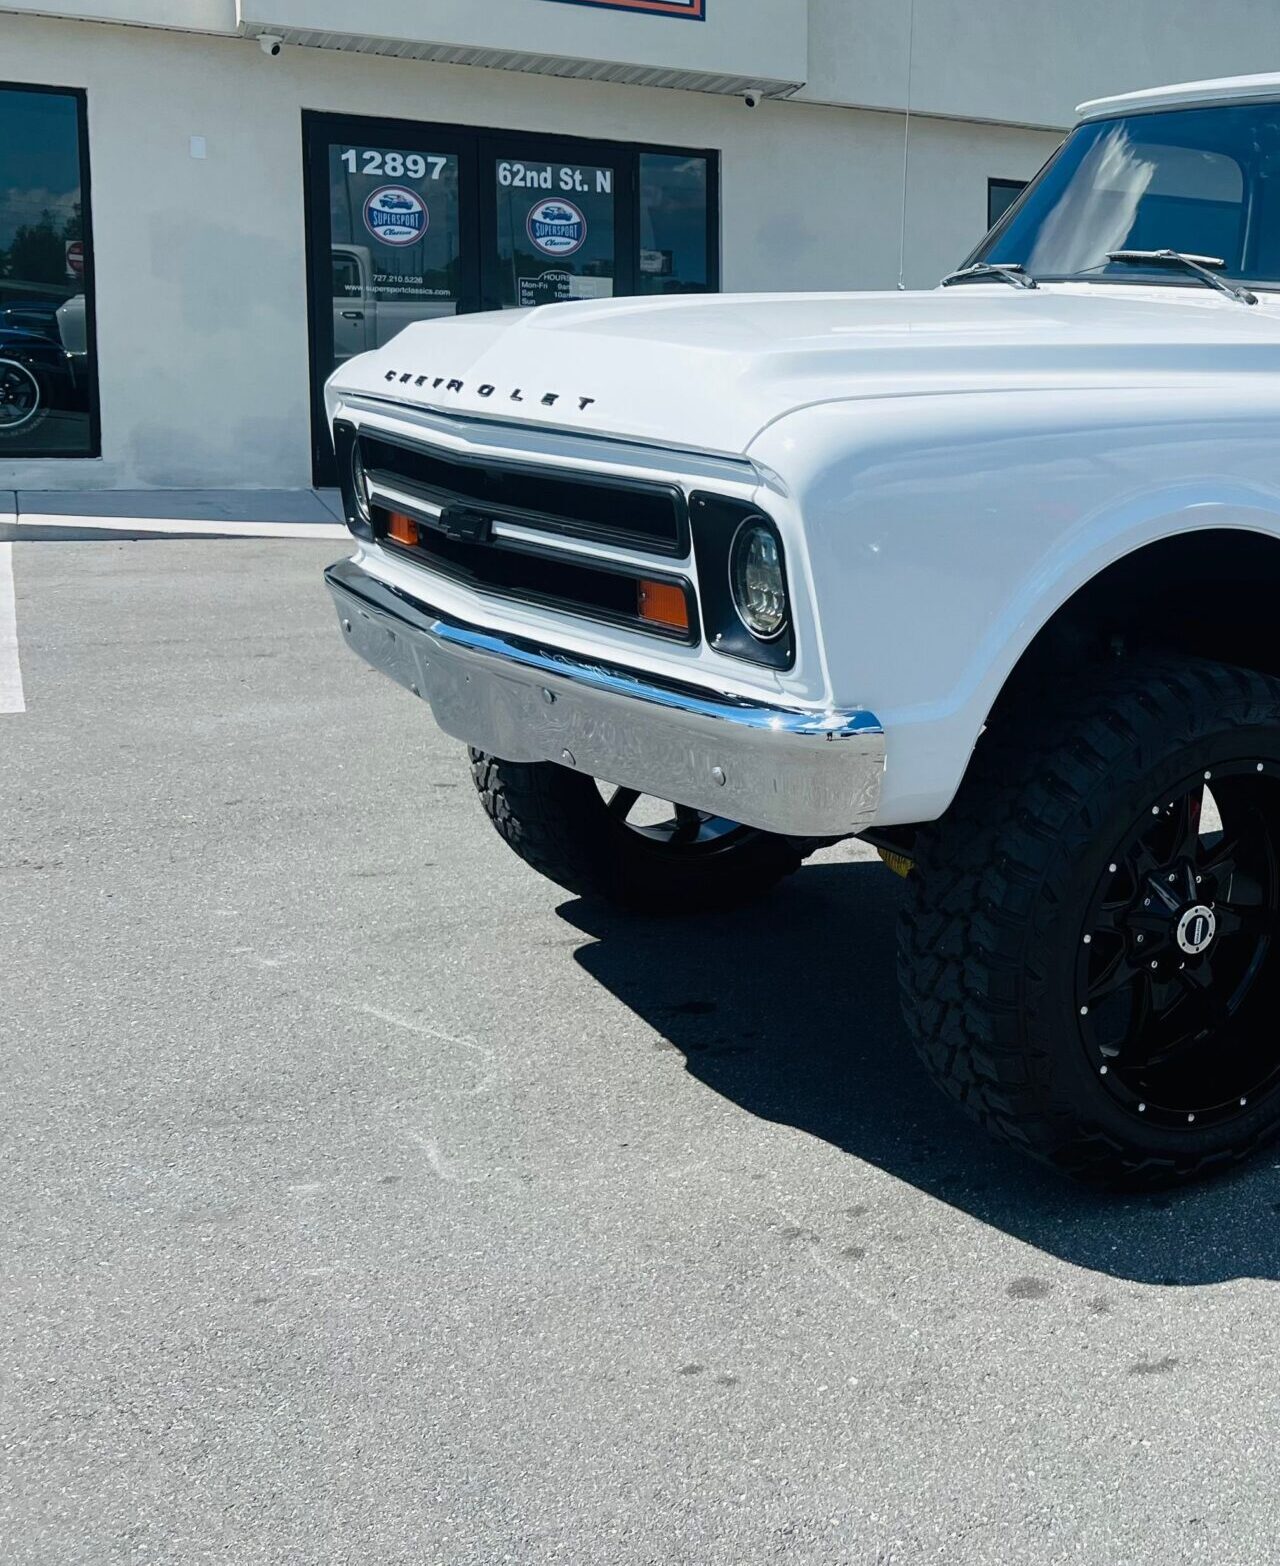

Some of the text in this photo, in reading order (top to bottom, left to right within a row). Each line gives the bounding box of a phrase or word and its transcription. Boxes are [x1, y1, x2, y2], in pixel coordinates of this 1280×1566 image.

[341, 149, 447, 180] 12897
[499, 162, 611, 193] 62nd St. N
[373, 210, 419, 228] SUPERSPORT
[535, 222, 578, 239] SUPERSPORT
[521, 281, 548, 289] Mon-Fri
[384, 369, 596, 411] CHEVROLET
